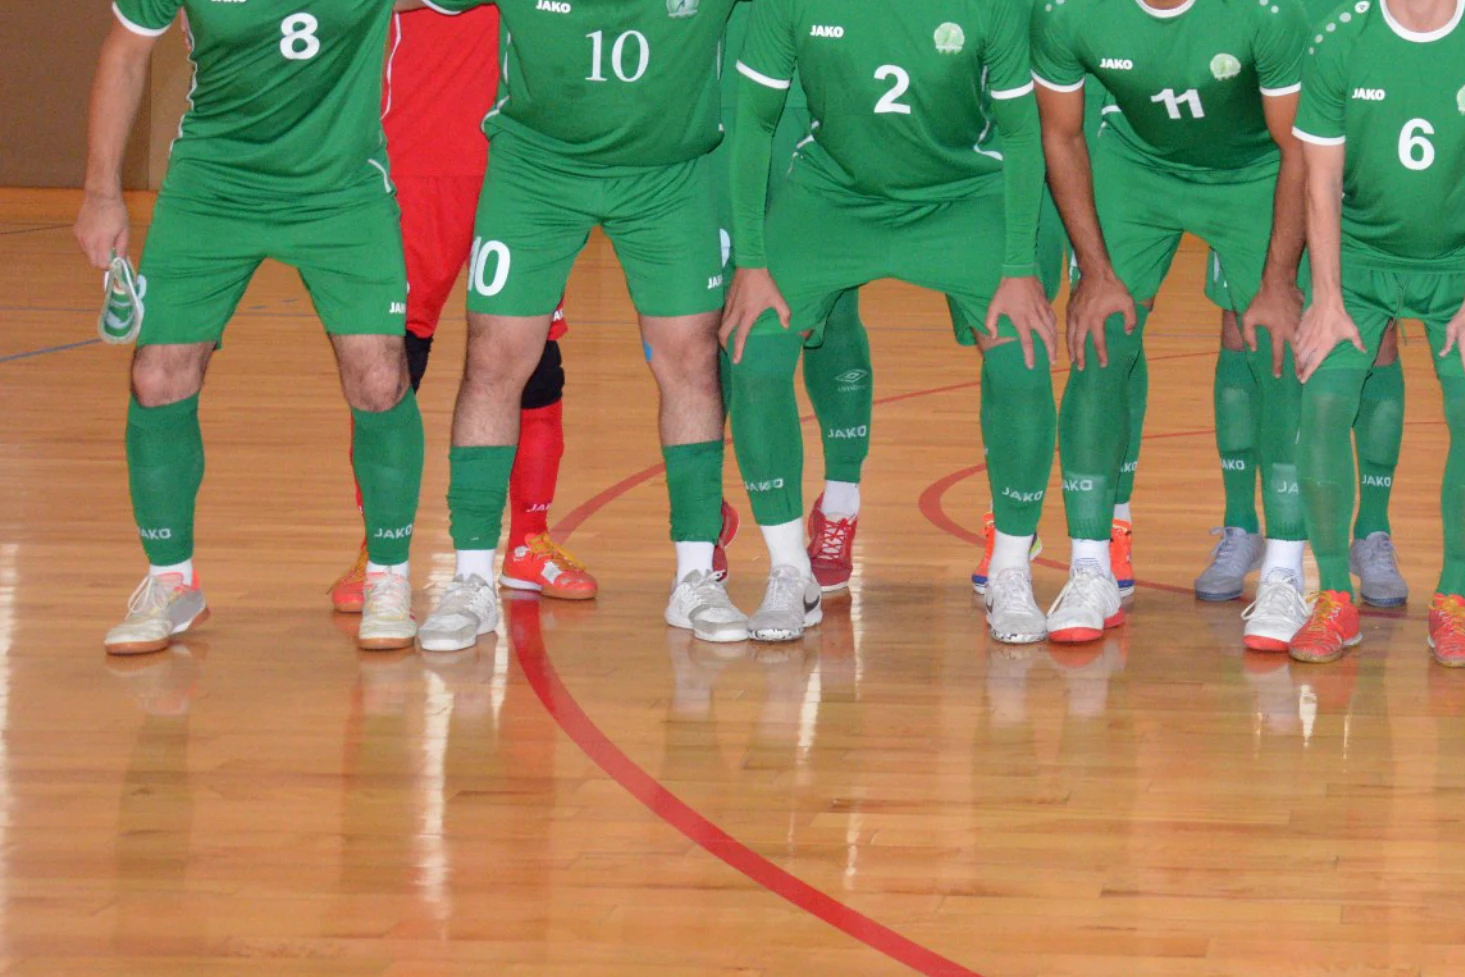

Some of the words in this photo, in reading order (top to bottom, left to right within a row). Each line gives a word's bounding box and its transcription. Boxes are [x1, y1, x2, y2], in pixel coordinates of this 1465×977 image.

[536, 0, 571, 13] JAKO
[280, 13, 320, 59] 8
[810, 25, 844, 38] JAKO
[586, 30, 649, 82] 10
[1100, 59, 1133, 70] JAKO
[874, 65, 910, 114] 2
[1352, 88, 1385, 100] JAKO
[1151, 89, 1204, 119] 11
[1398, 118, 1434, 170] 6
[828, 425, 867, 439] JAKO
[1362, 474, 1392, 488] JAKO
[1001, 487, 1043, 502] JAKO
[374, 524, 413, 539] JAKO
